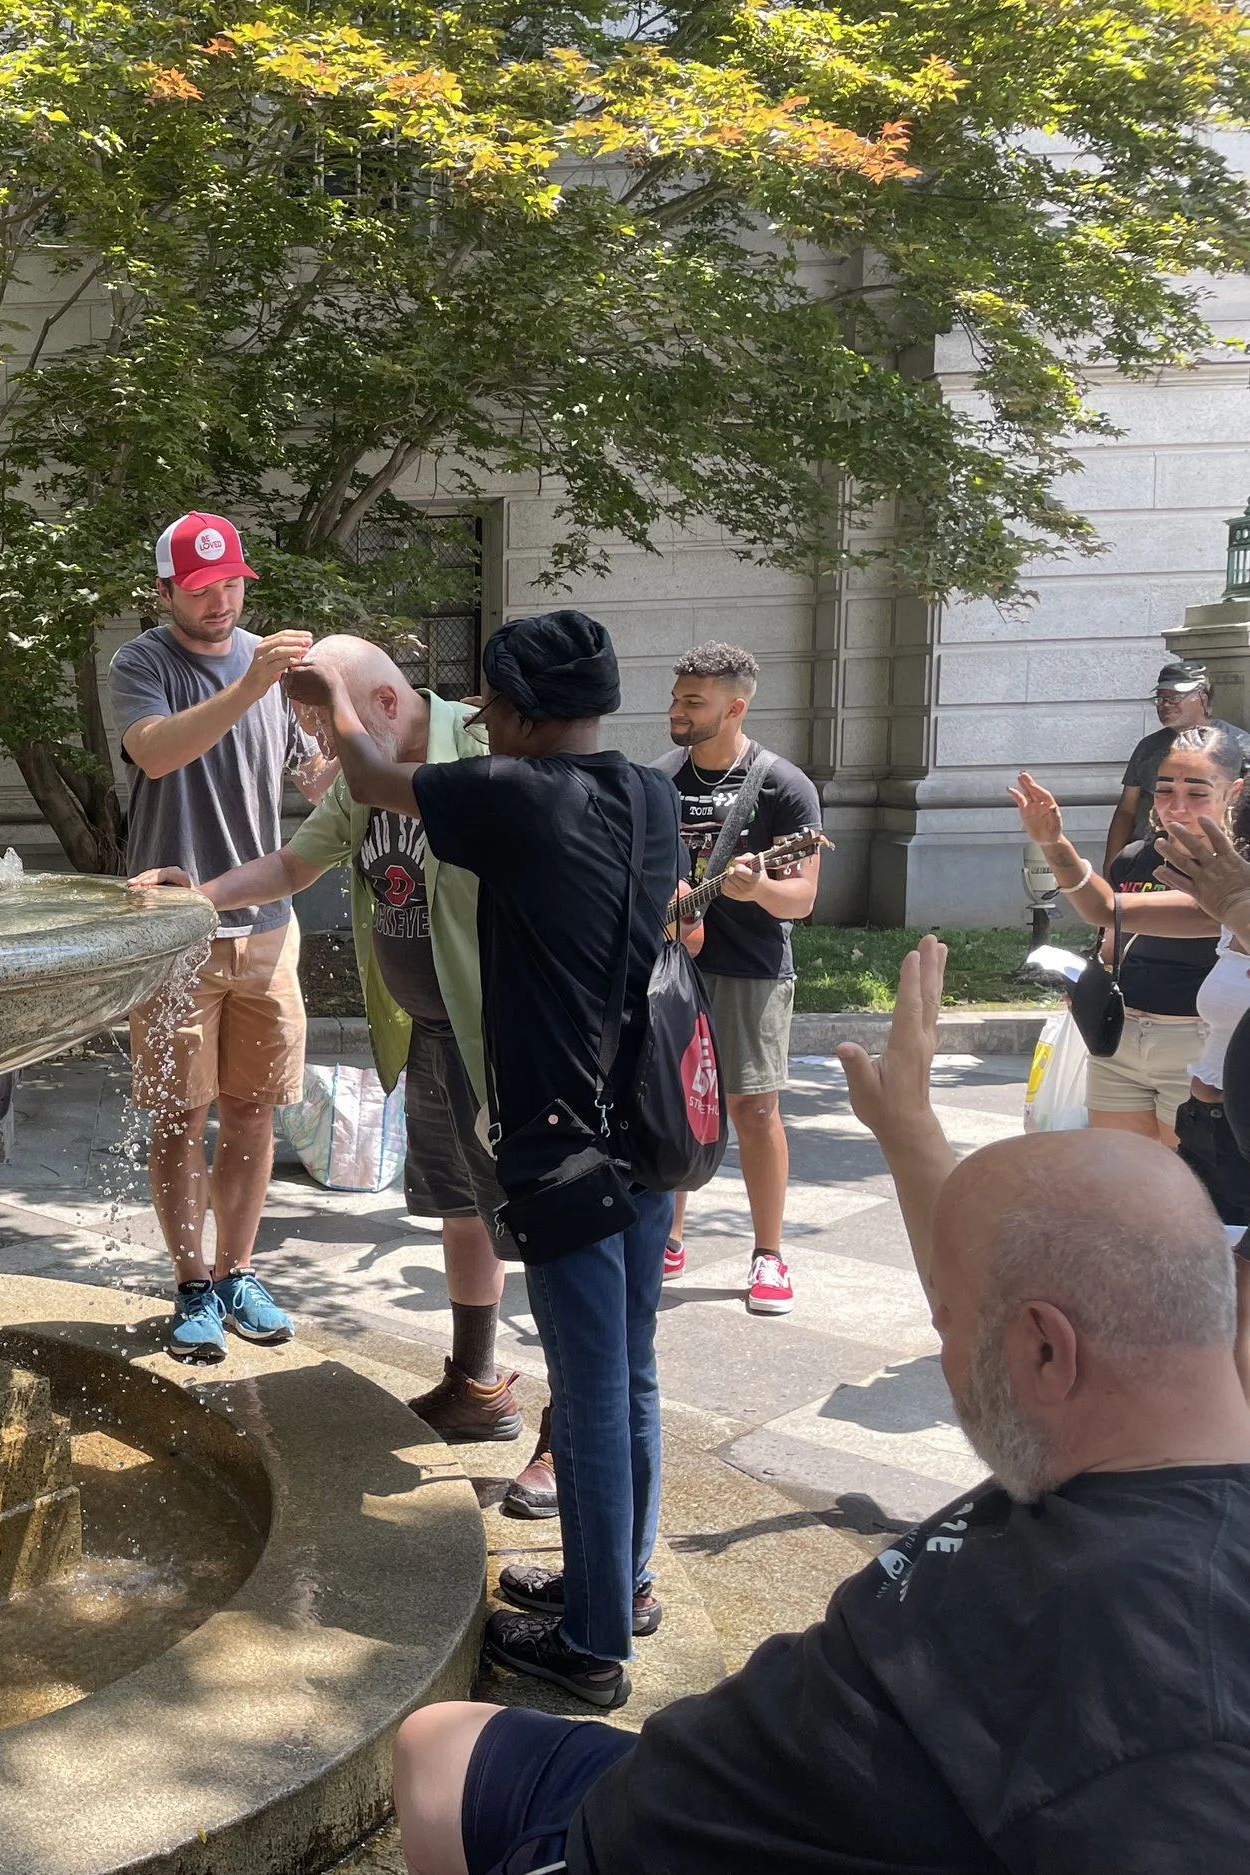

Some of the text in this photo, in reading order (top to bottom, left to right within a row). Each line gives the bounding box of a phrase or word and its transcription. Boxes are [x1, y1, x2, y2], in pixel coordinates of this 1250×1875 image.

[201, 534, 211, 543] BE
[199, 540, 222, 551] LOVED
[689, 806, 714, 816] TOUR
